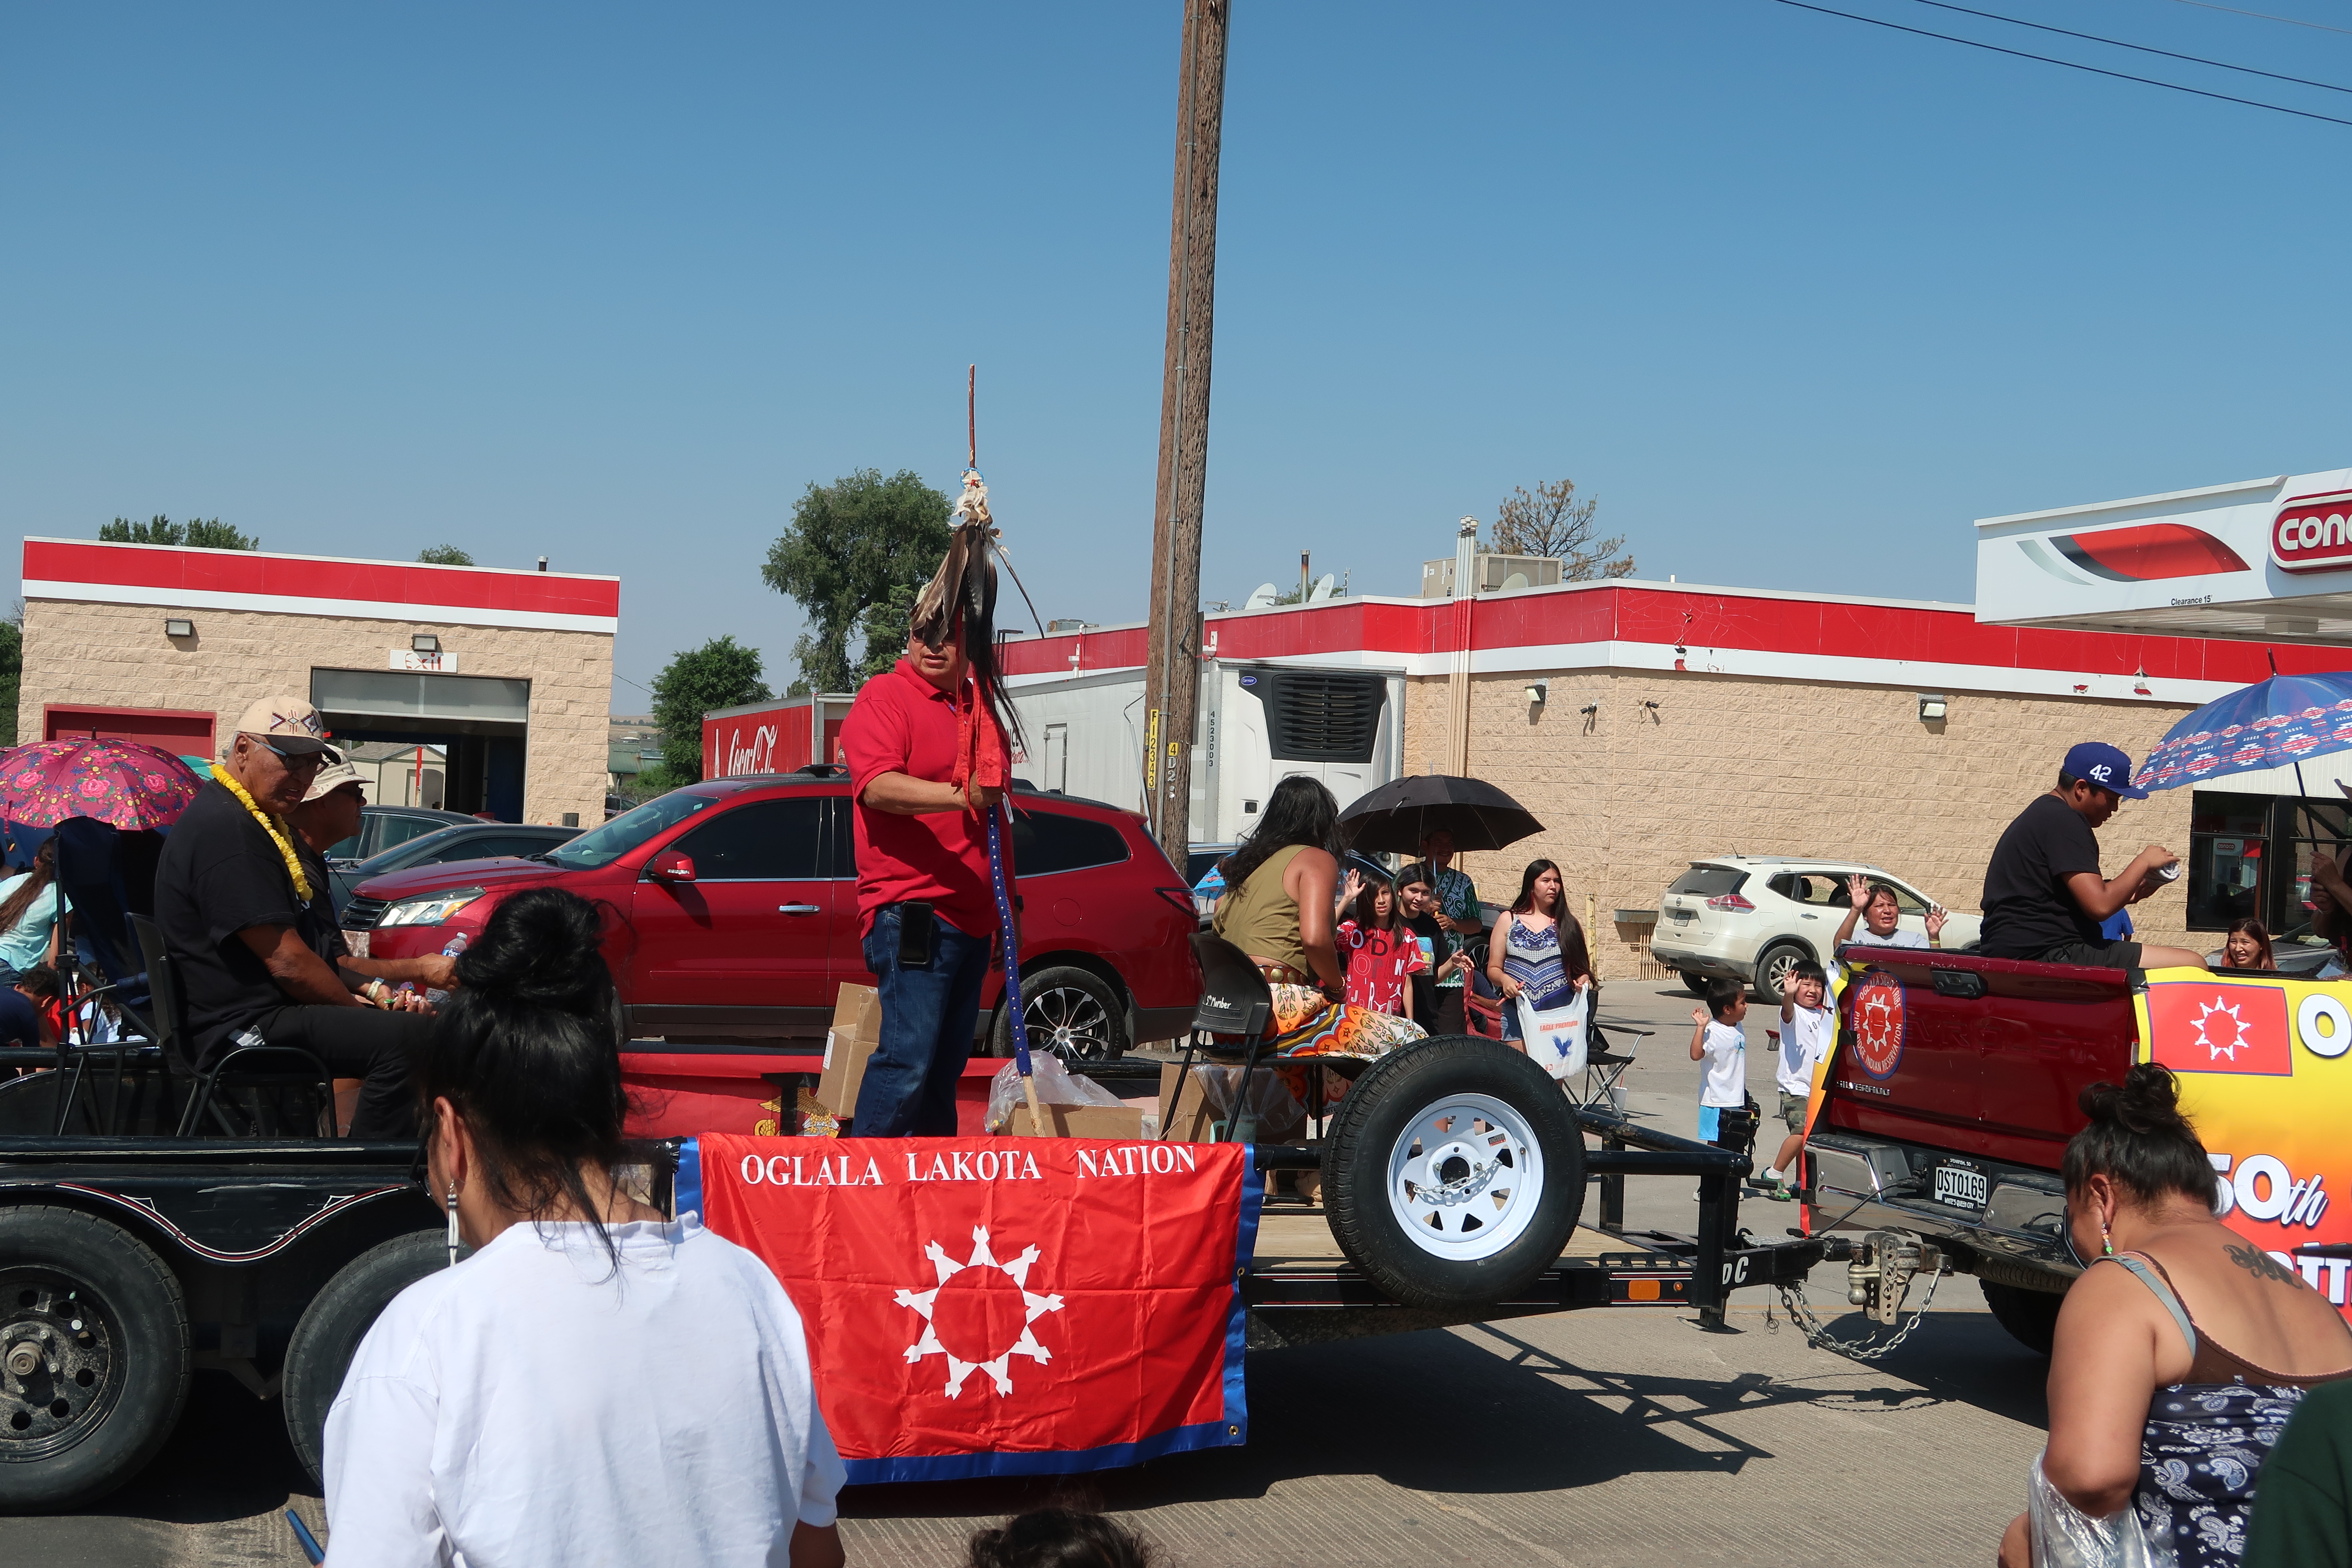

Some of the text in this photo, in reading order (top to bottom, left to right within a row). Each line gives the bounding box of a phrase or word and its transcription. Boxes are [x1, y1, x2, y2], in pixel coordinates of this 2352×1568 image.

[2278, 513, 2352, 551] con
[2171, 597, 2202, 606] Clearance
[1170, 744, 1176, 756] 4
[2089, 764, 2112, 783] 42
[1859, 974, 1902, 1011] OGLALA SIOUX TRIBE
[1210, 997, 1232, 1009] Member
[1556, 1020, 1578, 1029] PREMIUM
[1856, 1033, 1867, 1060] RIDGE
[1865, 1054, 1882, 1072] INDIAN
[1882, 1023, 1902, 1072] RESERVATION
[1837, 1080, 1890, 1096] SILVERADO
[741, 1145, 1195, 1185] OGLALA LAKOTA NATION
